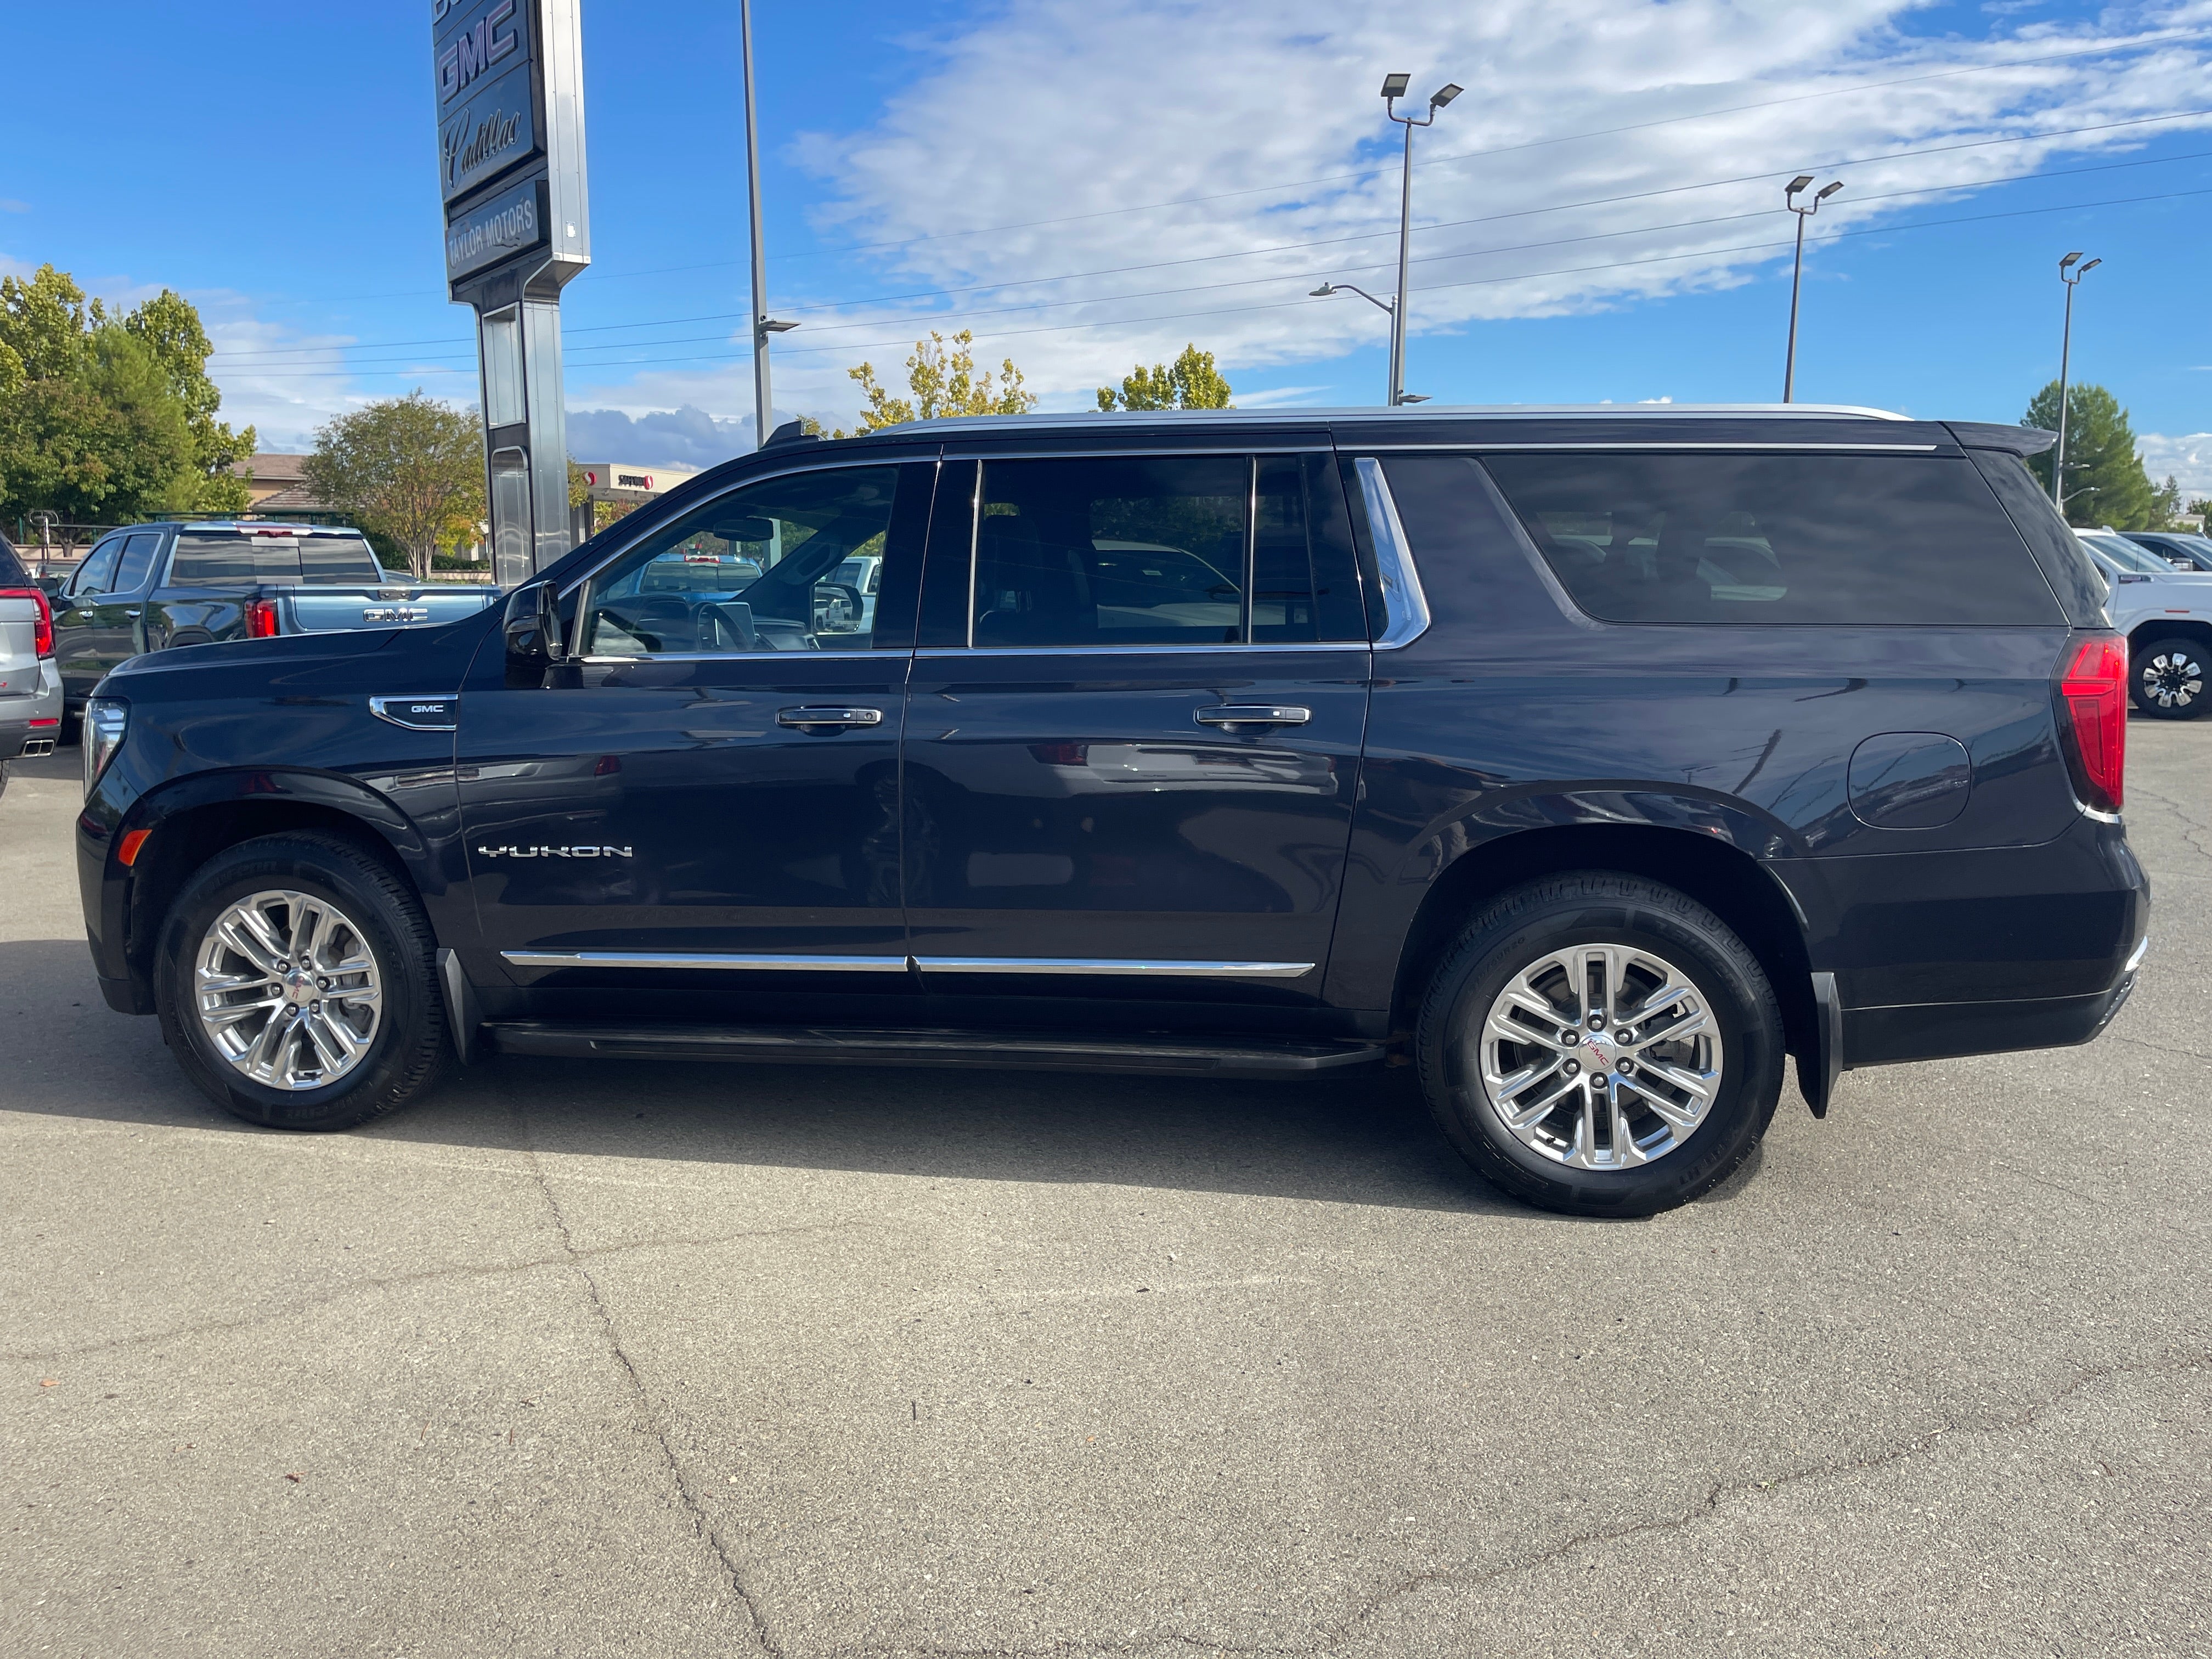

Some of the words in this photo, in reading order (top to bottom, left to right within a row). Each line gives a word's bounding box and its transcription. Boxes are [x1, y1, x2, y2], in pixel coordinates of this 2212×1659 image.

[439, 0, 516, 104] GMC
[445, 108, 521, 189] Cadillac
[449, 225, 483, 267] TAYLOR
[485, 200, 532, 247] MOTORS
[364, 608, 428, 622] GMC
[478, 846, 632, 857] YUKON
[1587, 1040, 1609, 1066] GMC
